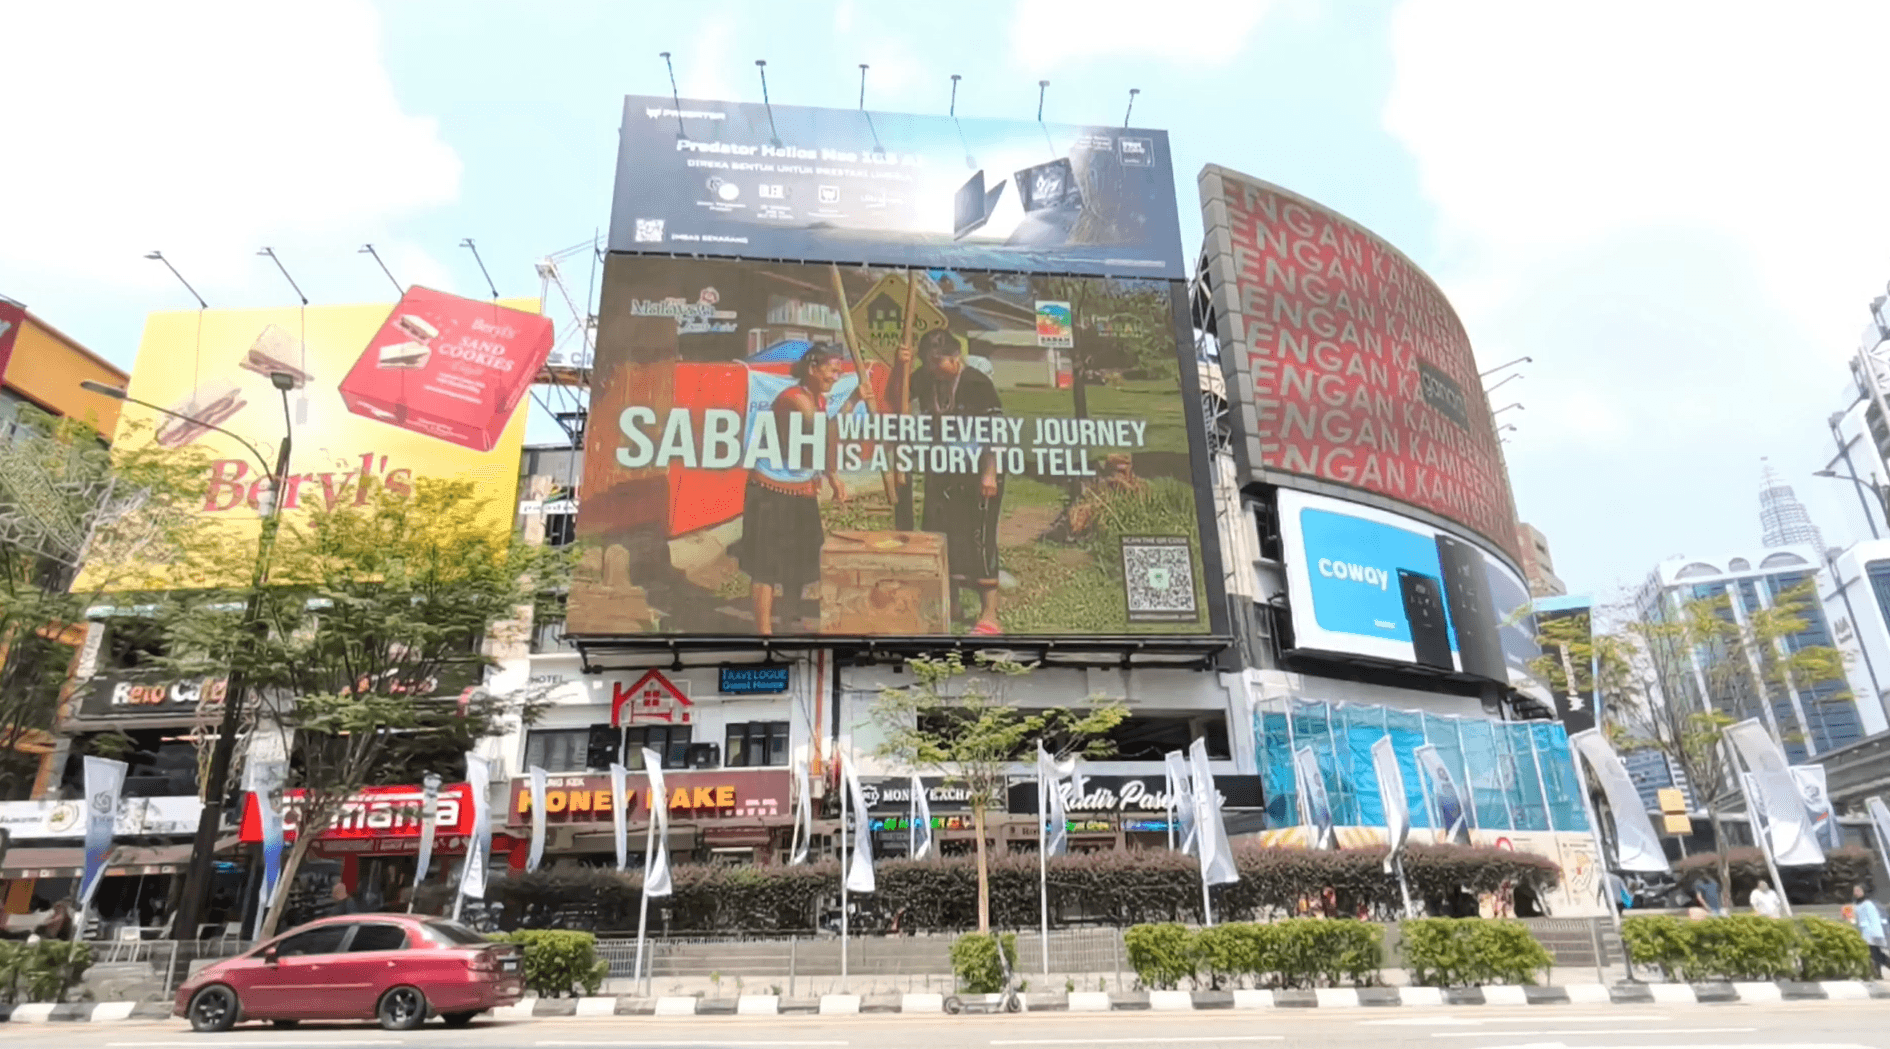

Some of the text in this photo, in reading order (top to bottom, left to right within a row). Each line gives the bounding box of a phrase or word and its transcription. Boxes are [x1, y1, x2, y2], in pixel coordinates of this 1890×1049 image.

[676, 139, 757, 156] Predator
[761, 144, 817, 160] Helios
[686, 159, 729, 169] DIREKA
[731, 162, 775, 173] BENTUK
[1235, 243, 1376, 329] ENGAN
[1241, 283, 1382, 359] ENGAN
[1391, 340, 1420, 373] KA
[437, 343, 516, 373] COOKIES
[460, 336, 506, 358] SAND
[1247, 320, 1389, 390] ENGAN
[1252, 357, 1394, 423] ENGAN
[616, 406, 826, 470] SABAH
[837, 412, 1147, 447] WHERE EVERY JOURNEY
[1256, 398, 1399, 457] ENGAN
[837, 443, 1096, 476] IS A STORY TO TELL
[203, 452, 412, 514] Beryl's
[529, 674, 563, 684] HOTEL
[722, 668, 788, 681] TRAVELOGUE
[883, 788, 928, 801] MONY
